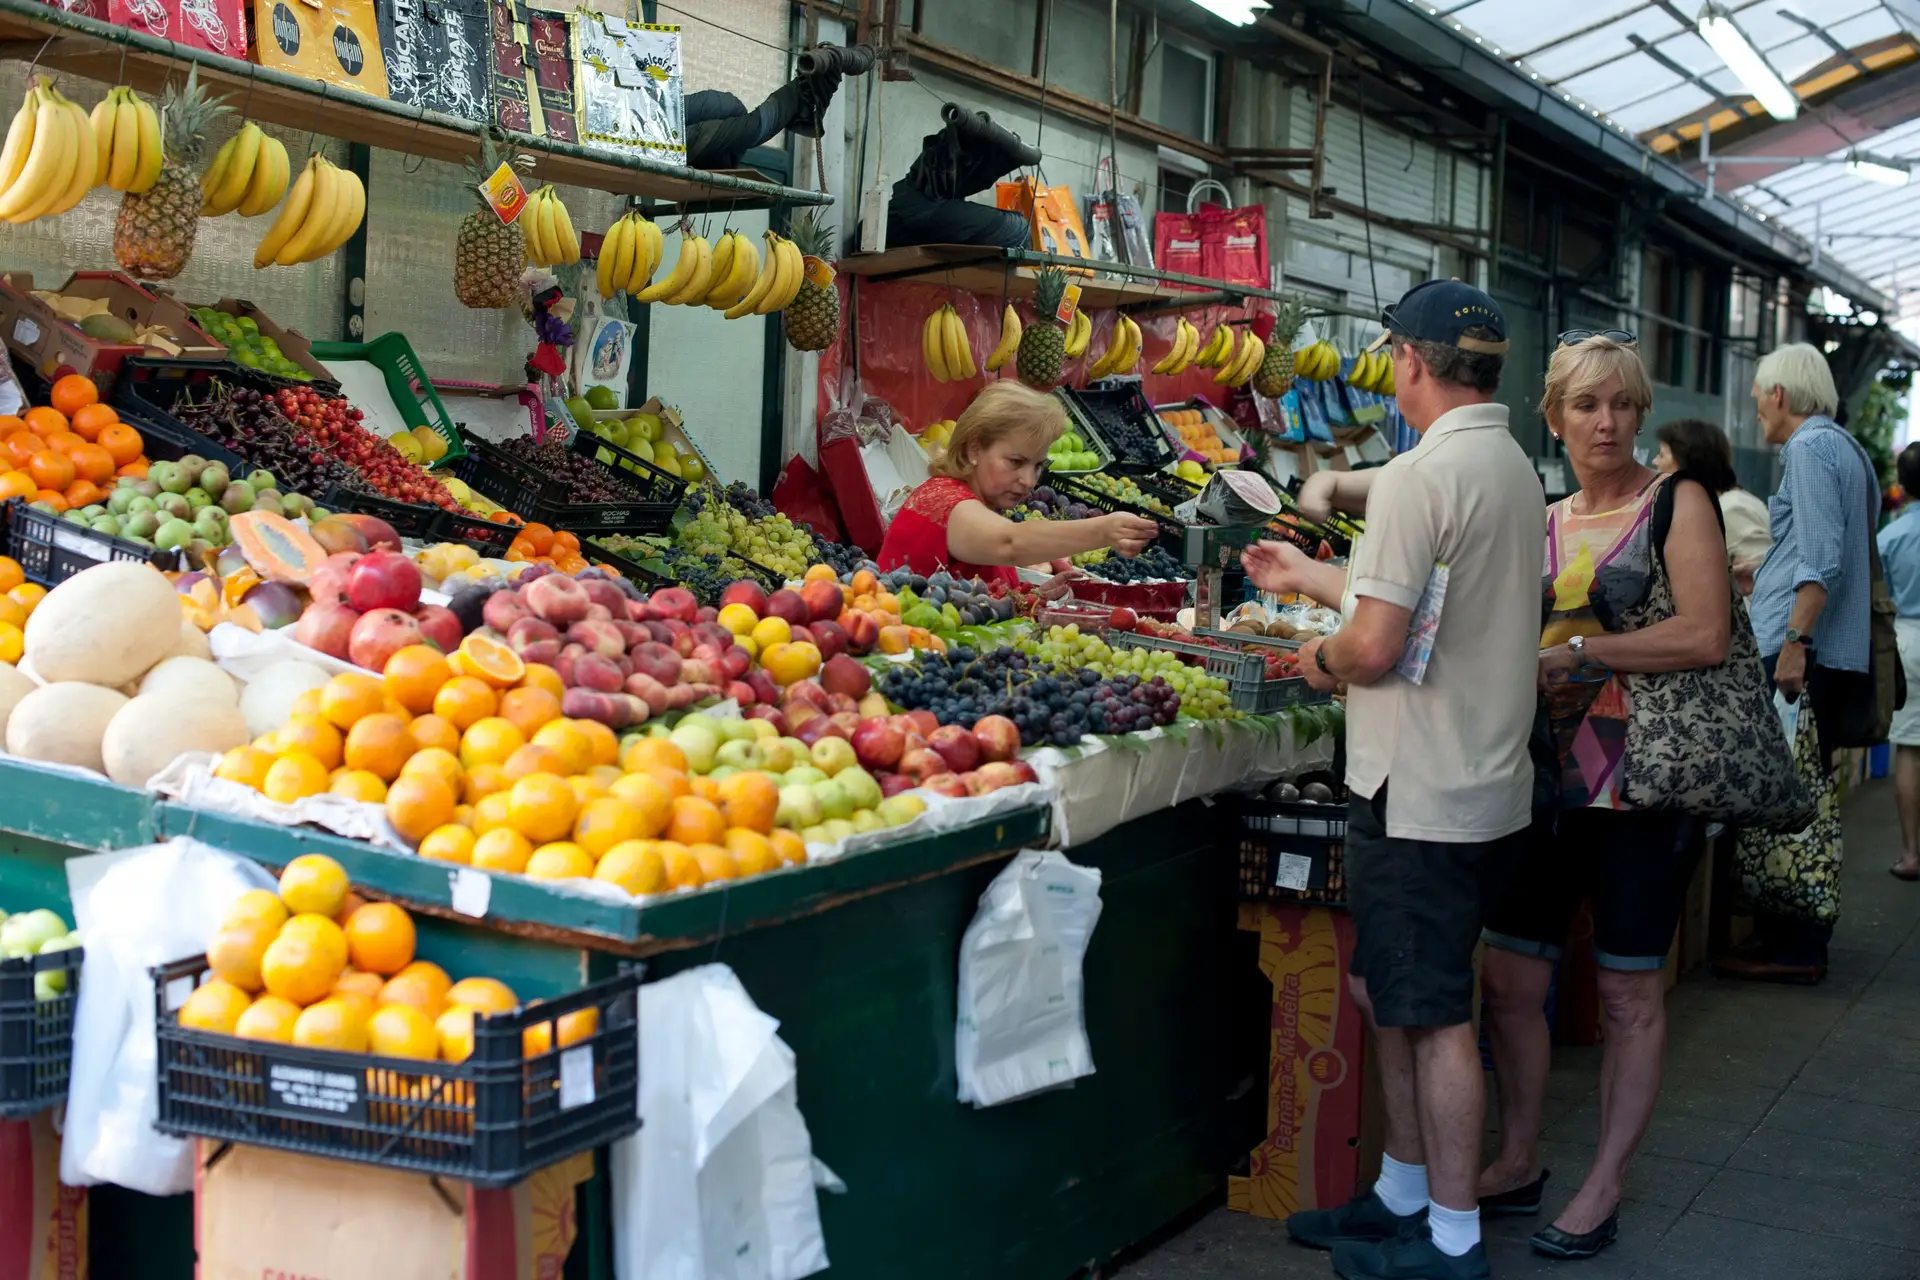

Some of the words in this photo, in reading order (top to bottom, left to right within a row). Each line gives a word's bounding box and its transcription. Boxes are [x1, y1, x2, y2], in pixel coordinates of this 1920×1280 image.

[273, 14, 299, 52] Bogani
[334, 36, 363, 72] Bogani
[636, 53, 677, 72] Belcafé
[1279, 973, 1298, 1056] Madeira
[1276, 1075, 1294, 1151] Banana
